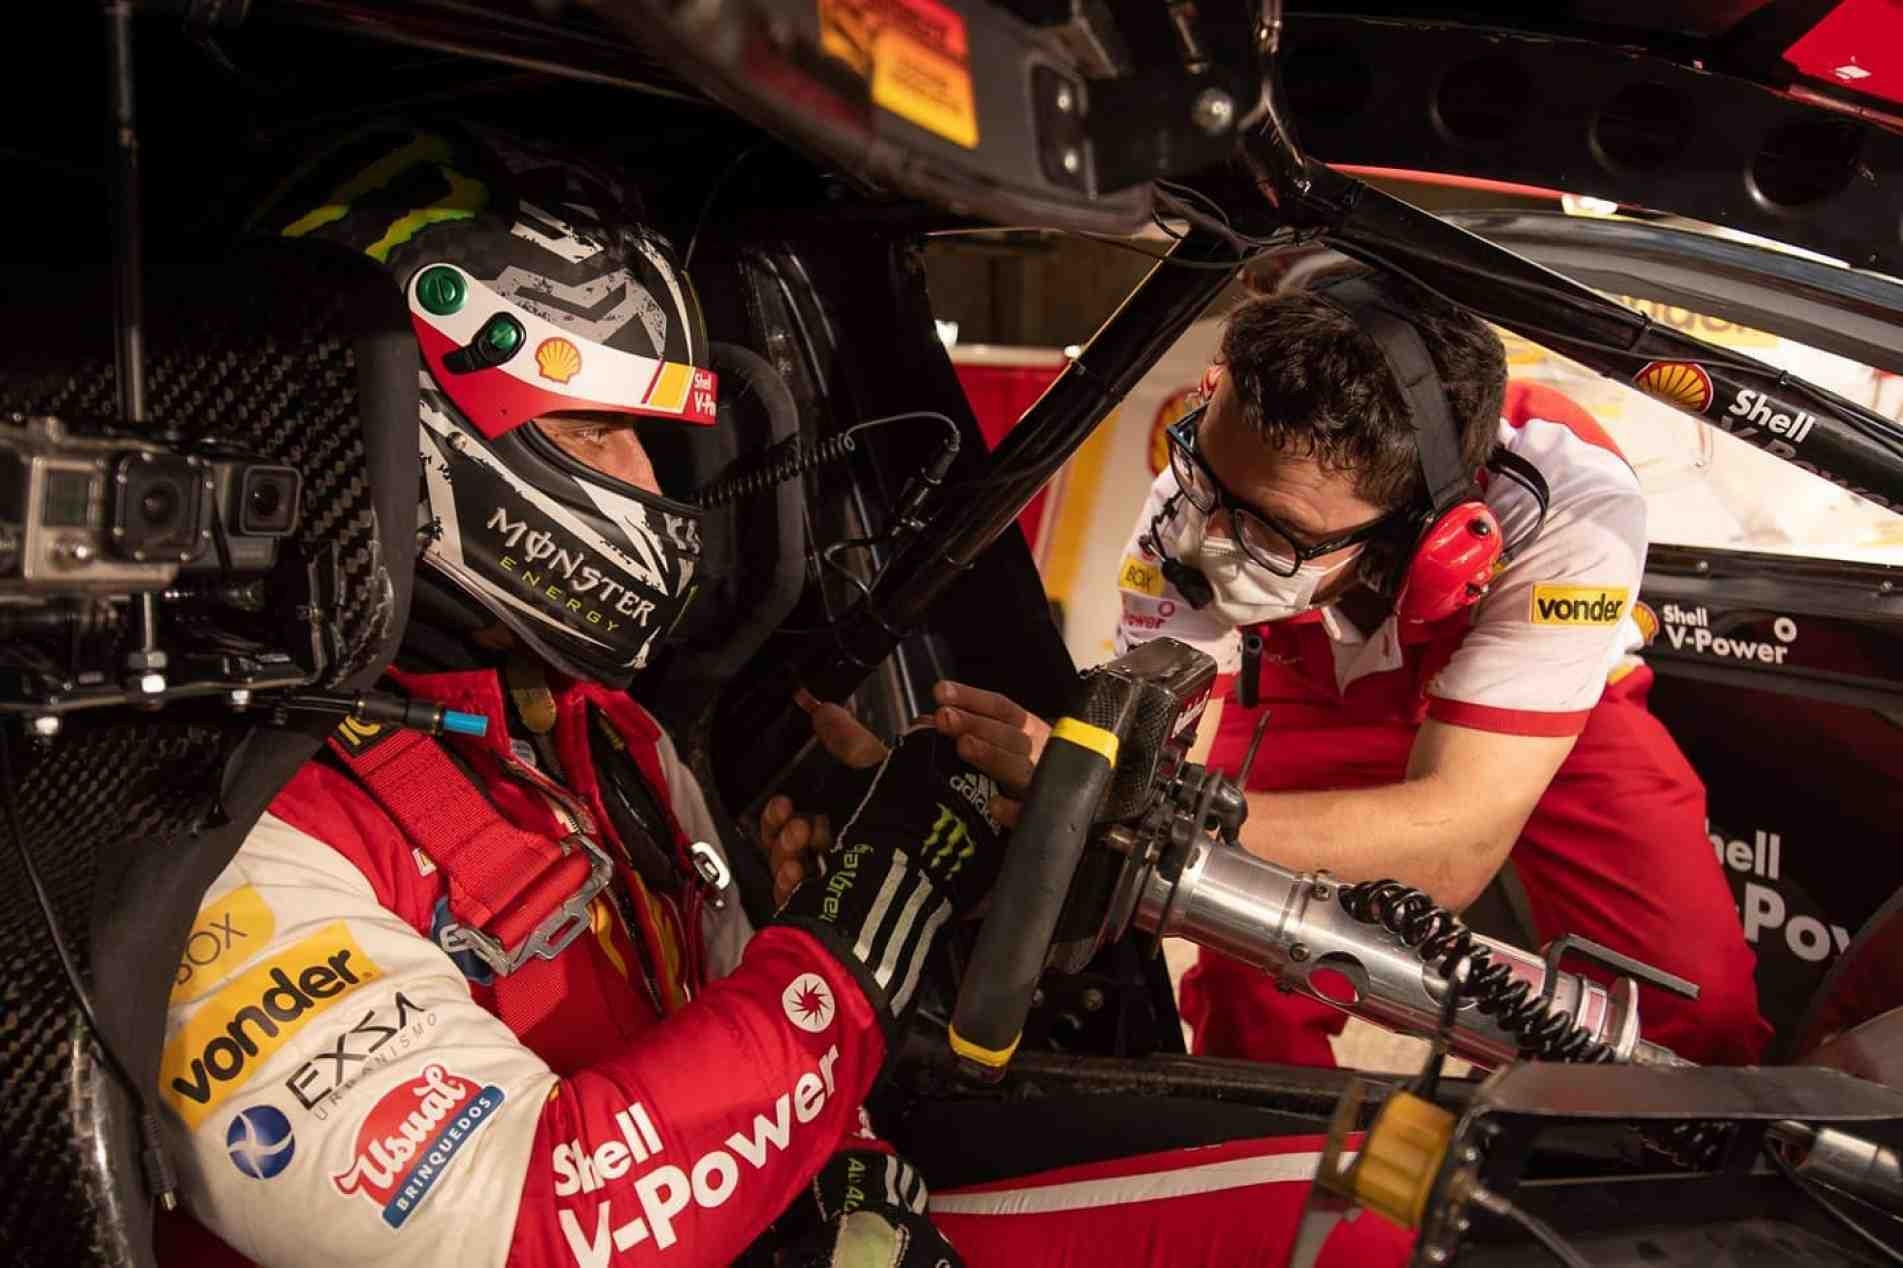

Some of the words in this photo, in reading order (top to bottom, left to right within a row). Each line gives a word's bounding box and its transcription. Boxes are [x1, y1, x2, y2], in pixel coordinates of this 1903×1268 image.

[1729, 389, 1817, 443] Shell
[499, 556, 620, 632] ENERGY
[1537, 594, 1623, 622] vonder
[1663, 604, 1708, 627] Shell
[1665, 628, 1788, 664] V-Power
[172, 949, 360, 1105] vonder
[334, 1064, 467, 1195] Usual
[395, 1097, 492, 1212] BRINQUEDOS
[553, 1101, 665, 1198] Shell
[558, 1044, 840, 1268] V-Power
